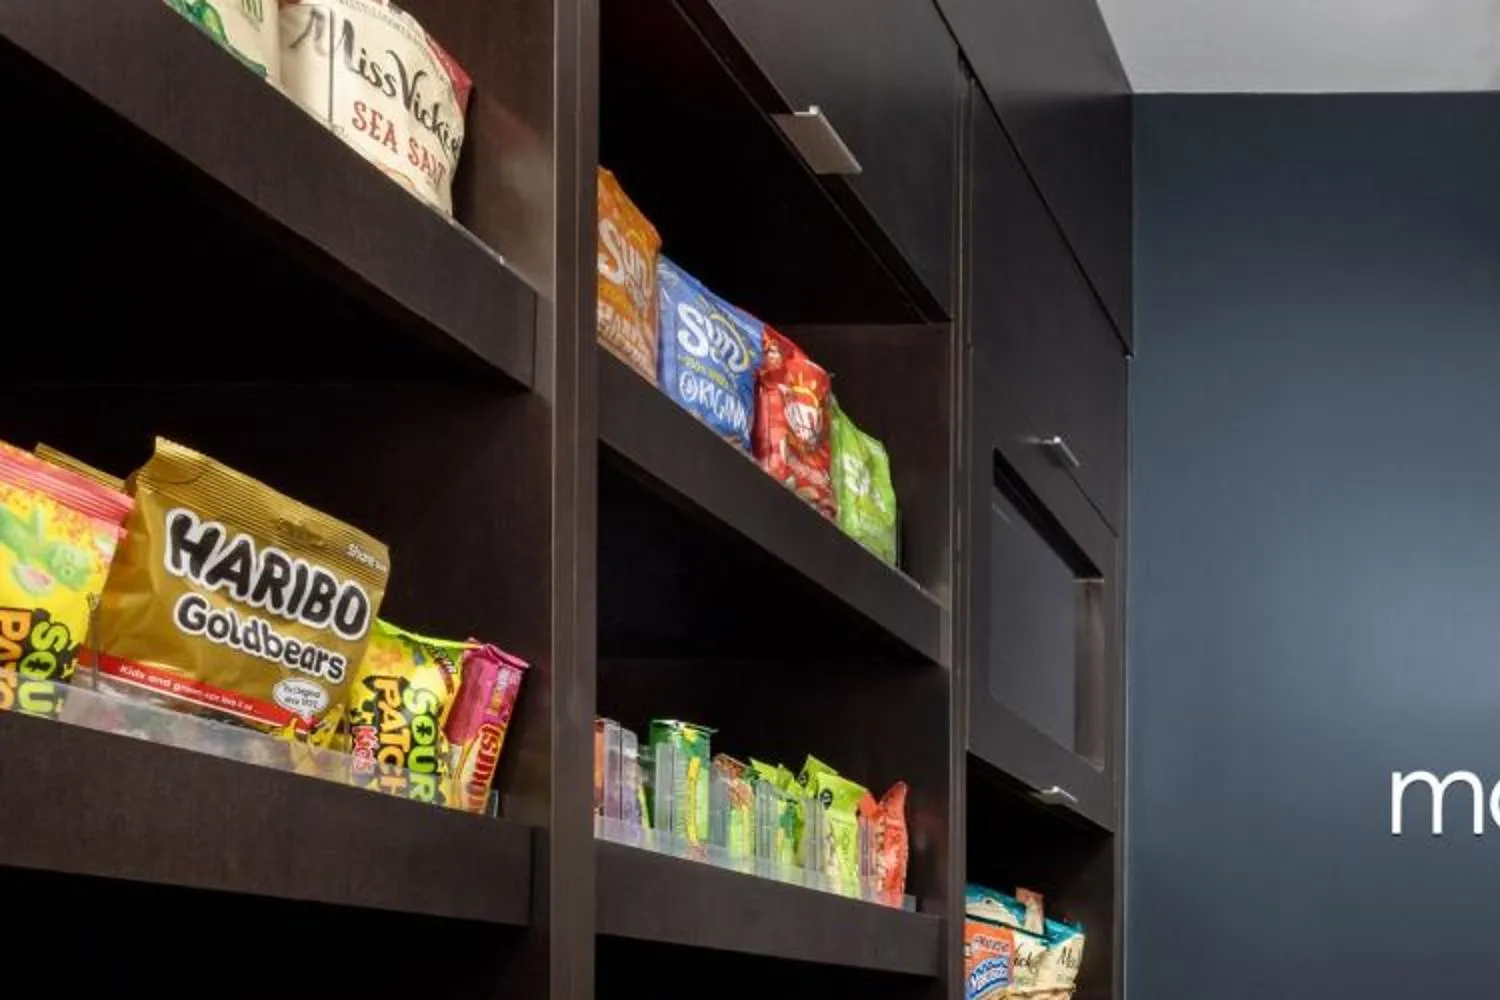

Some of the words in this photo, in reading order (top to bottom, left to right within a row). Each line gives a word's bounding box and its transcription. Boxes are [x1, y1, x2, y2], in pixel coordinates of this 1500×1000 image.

[352, 100, 399, 153] SEA
[677, 302, 749, 373] Sun
[166, 510, 371, 638] HARIBO
[119, 663, 146, 679] Kids
[176, 594, 346, 682] Goldbears
